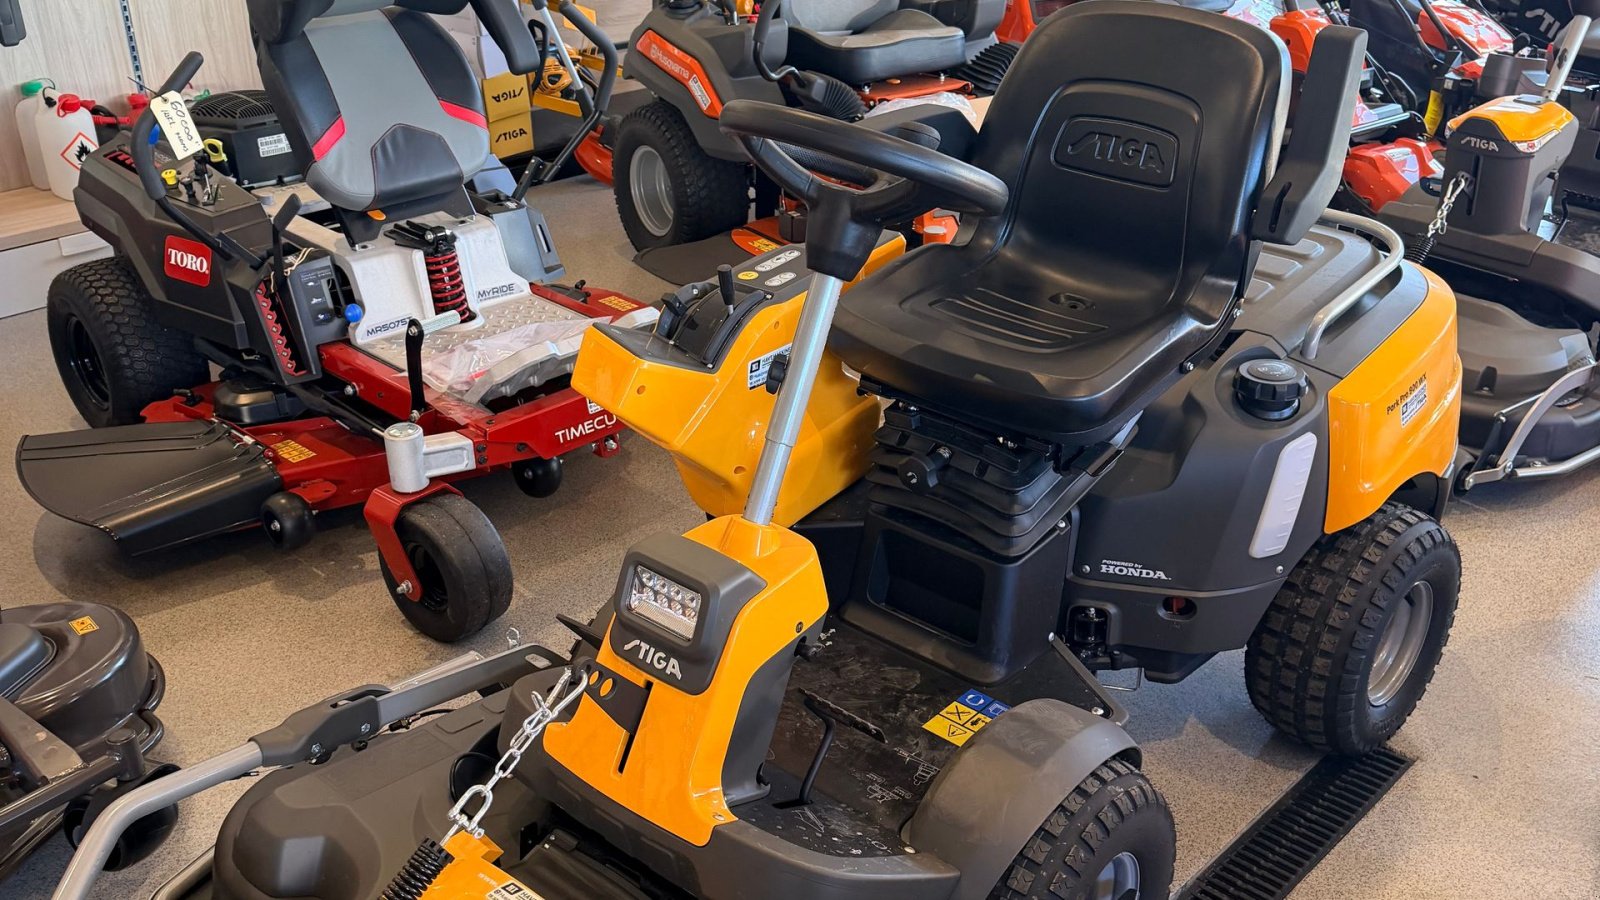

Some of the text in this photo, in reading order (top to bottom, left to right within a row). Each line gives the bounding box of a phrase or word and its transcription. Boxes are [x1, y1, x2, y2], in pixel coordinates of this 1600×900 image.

[491, 87, 524, 103] STIGA
[495, 128, 528, 143] STIGA
[1067, 131, 1165, 173] STIGA
[1461, 136, 1499, 152] STIGA
[168, 248, 208, 274] TORO
[1386, 399, 1400, 415] Park
[1400, 391, 1409, 404] Pro
[1102, 559, 1134, 567] POWERED
[1100, 564, 1169, 580] HONDA
[623, 639, 682, 680] STIGA
